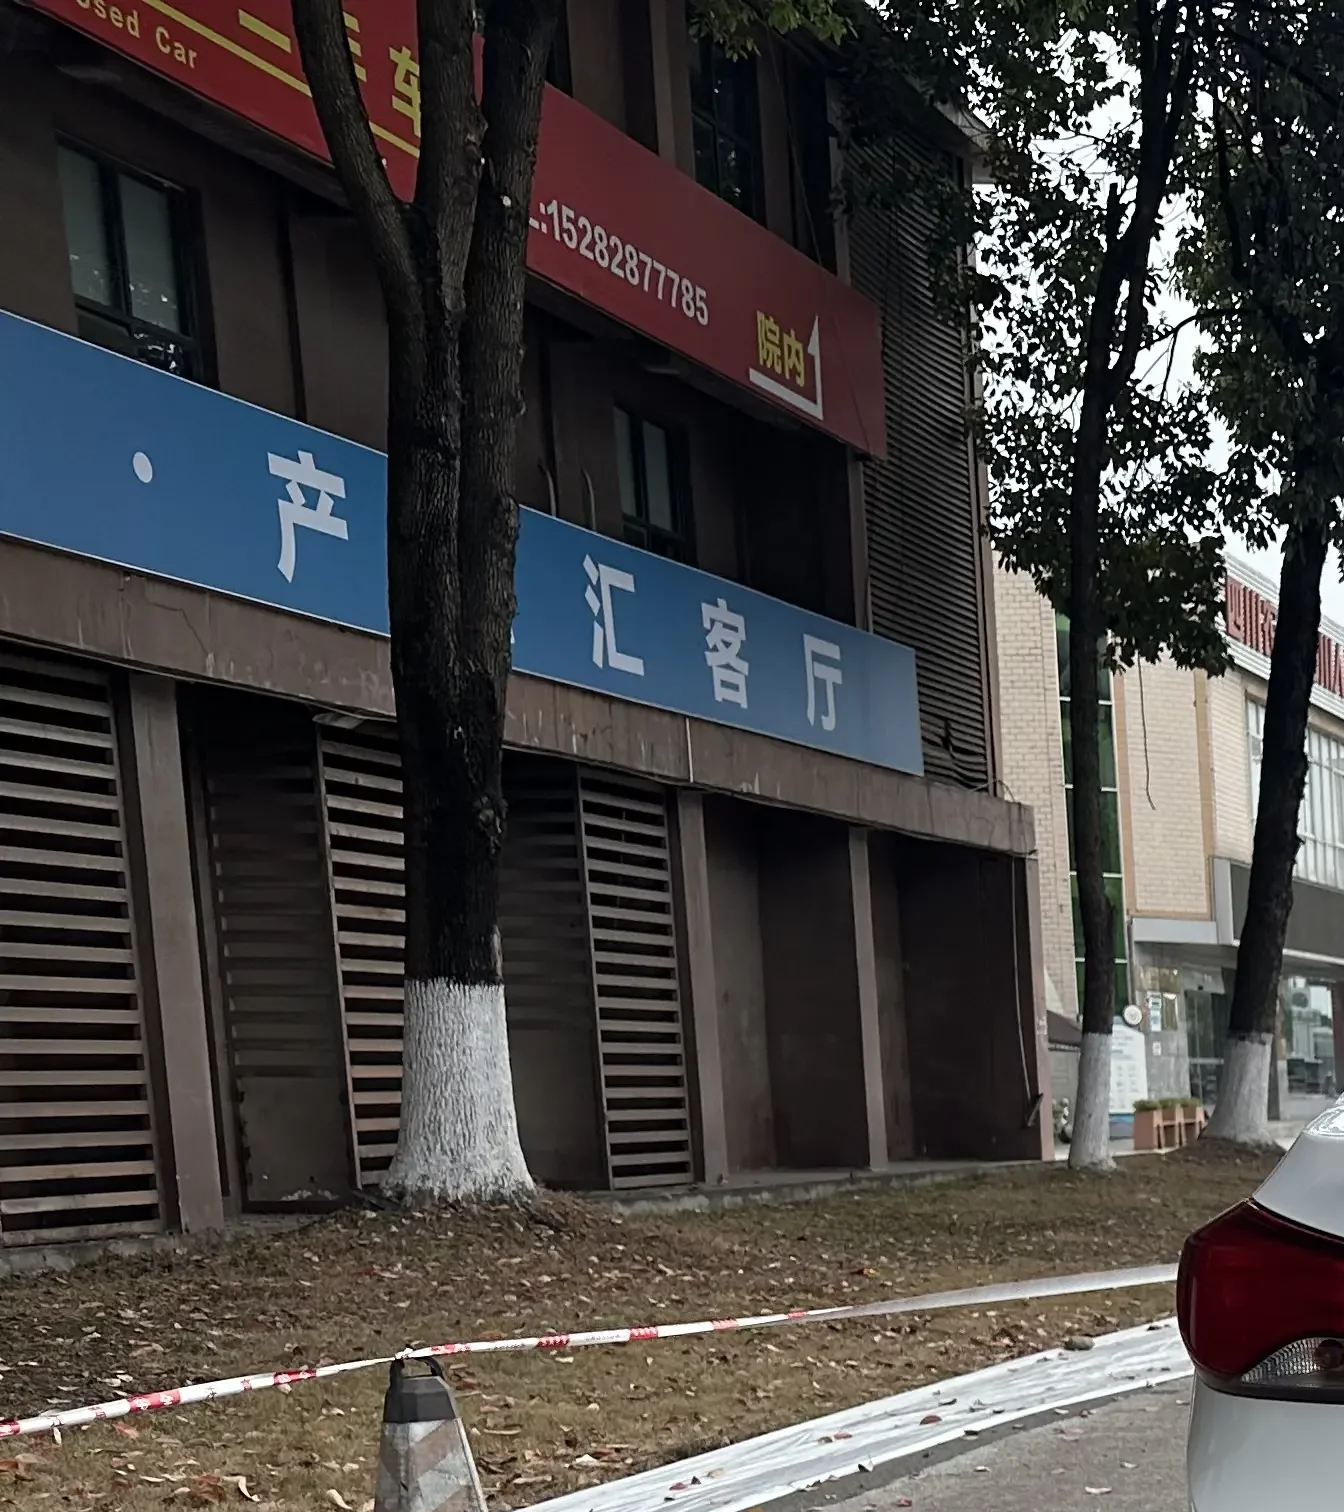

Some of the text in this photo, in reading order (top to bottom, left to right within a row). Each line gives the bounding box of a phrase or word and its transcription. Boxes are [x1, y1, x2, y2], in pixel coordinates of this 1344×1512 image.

[155, 26, 198, 69] Car
[528, 199, 710, 326] :15282877785
[756, 310, 806, 388] 院内
